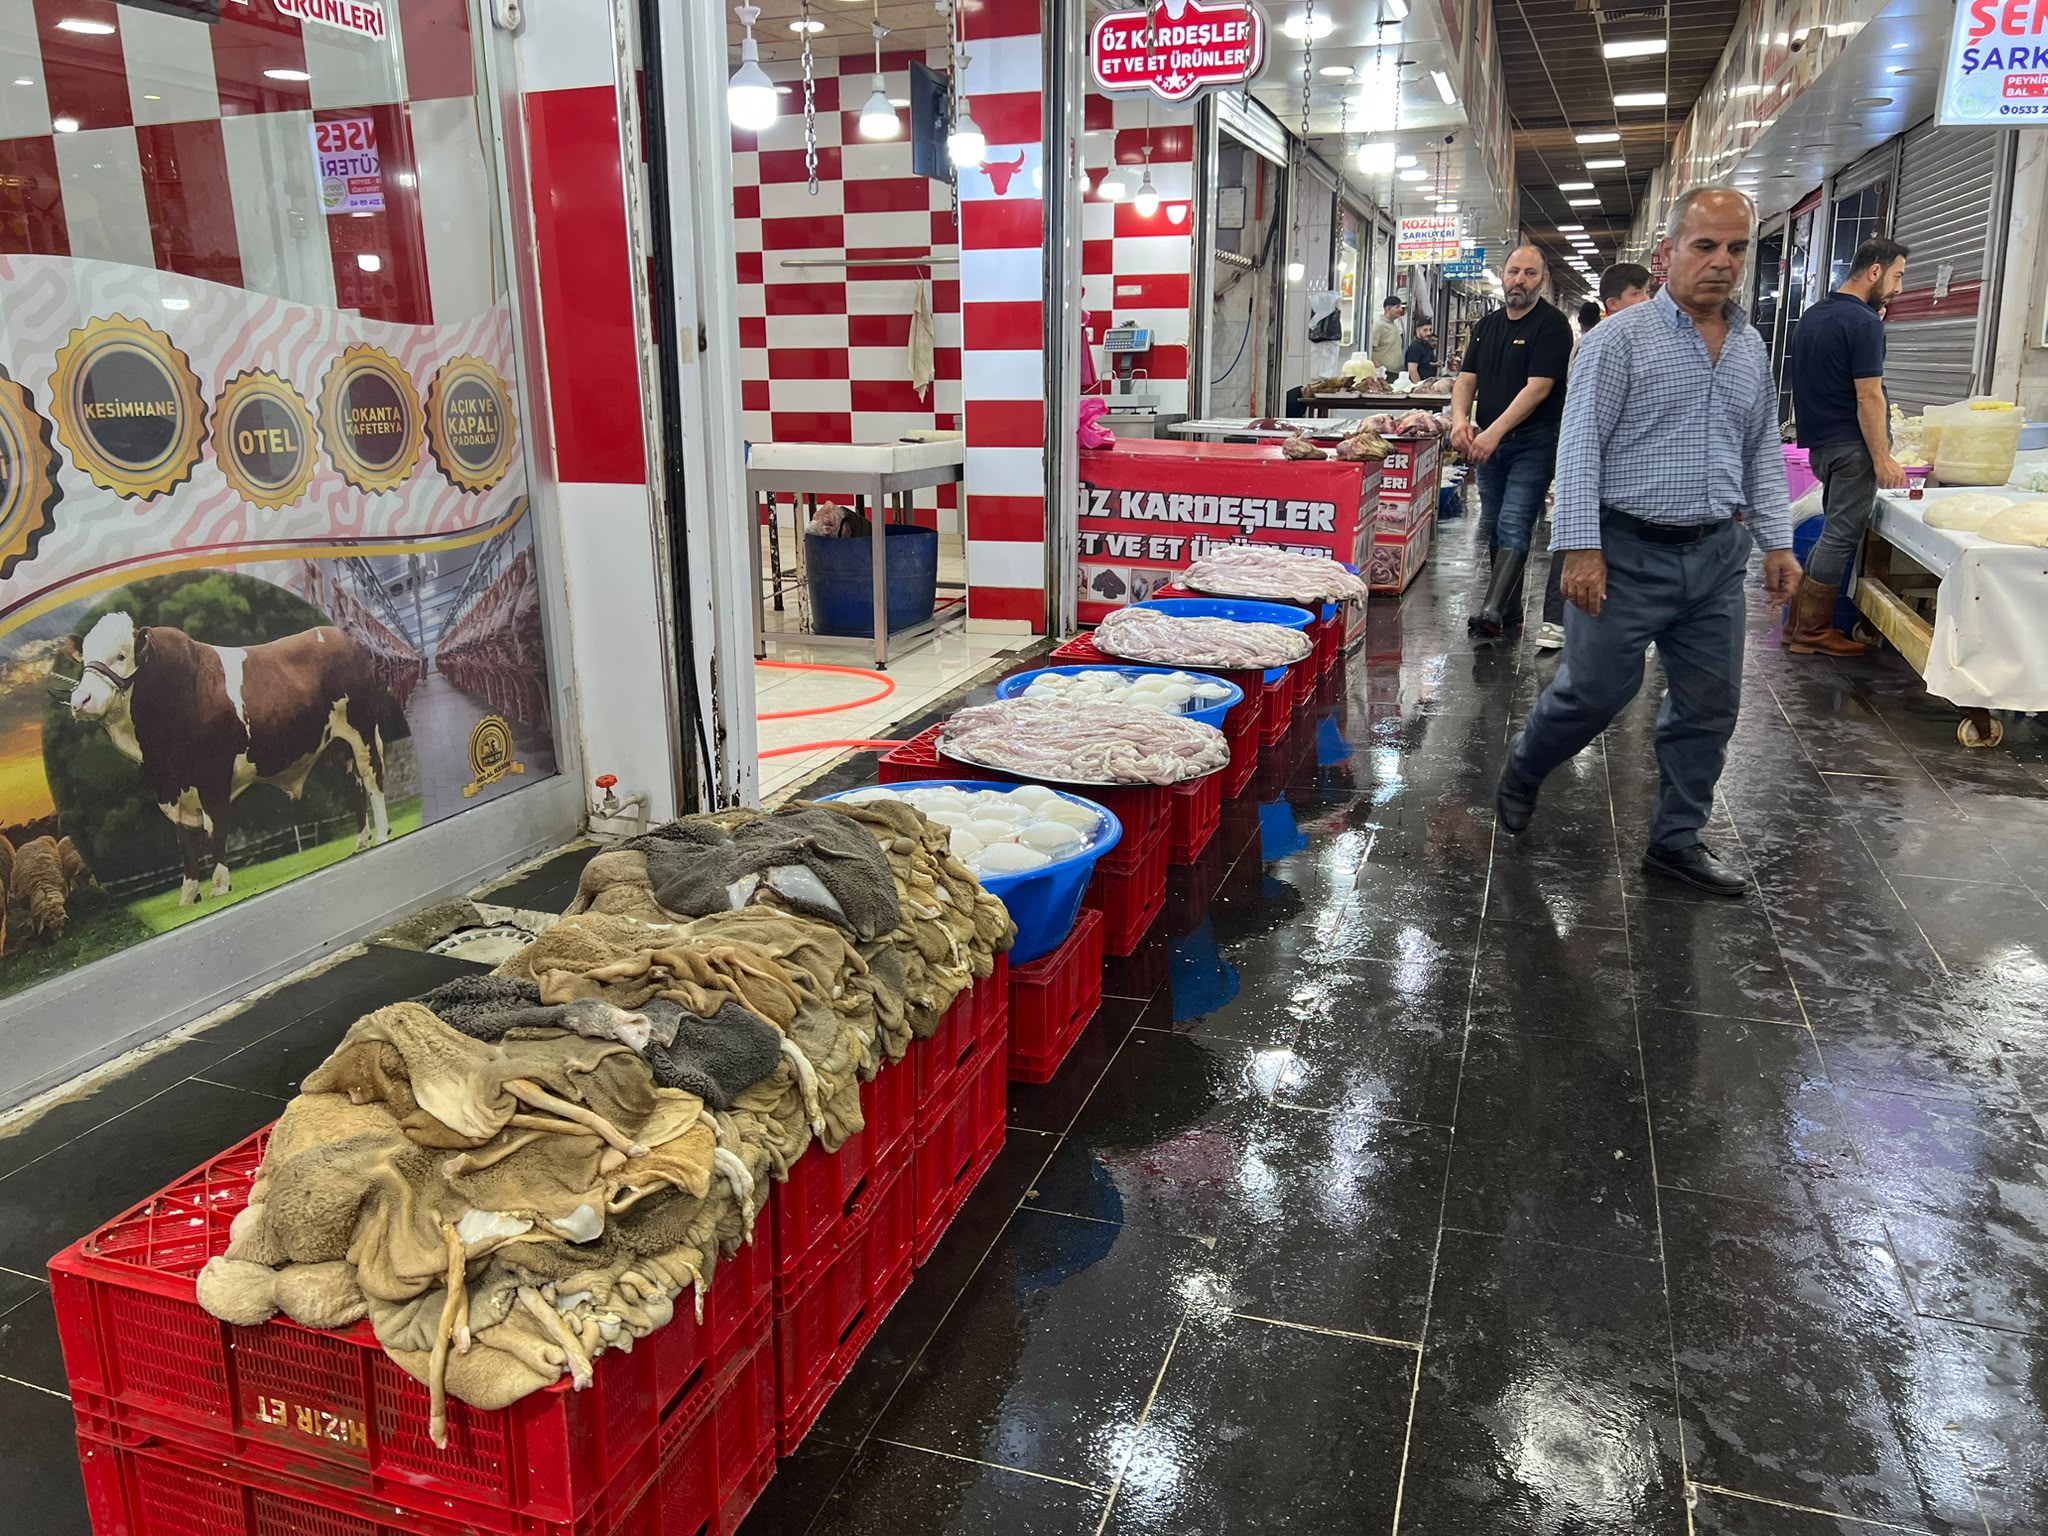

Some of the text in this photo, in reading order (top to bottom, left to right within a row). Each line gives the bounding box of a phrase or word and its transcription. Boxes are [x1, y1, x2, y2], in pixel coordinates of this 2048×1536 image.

[1102, 28, 1127, 51] ÖZ
[1102, 59, 1121, 75] ET
[1124, 57, 1144, 72] VE
[1147, 55, 1167, 70] ET
[1961, 46, 2048, 75] ŞARK
[2006, 88, 2029, 96] BAL
[2011, 105, 2039, 114] 0533
[1402, 217, 1456, 230] KOZLUK
[84, 398, 176, 418] KESİMHANE
[344, 406, 401, 422] LOKANTA
[451, 398, 493, 414] AÇIK VE
[346, 422, 403, 436] KAFETERYA
[449, 415, 498, 434] KAPALI
[238, 428, 298, 456] OTEL
[453, 434, 497, 446] PADOKLAR
[1379, 476, 1408, 489] ERİ
[1119, 490, 1335, 534] KARDEŞLER
[1078, 532, 1099, 556] T
[1105, 533, 1142, 558] VE
[1148, 535, 1185, 561] ET
[255, 1395, 288, 1427] ET
